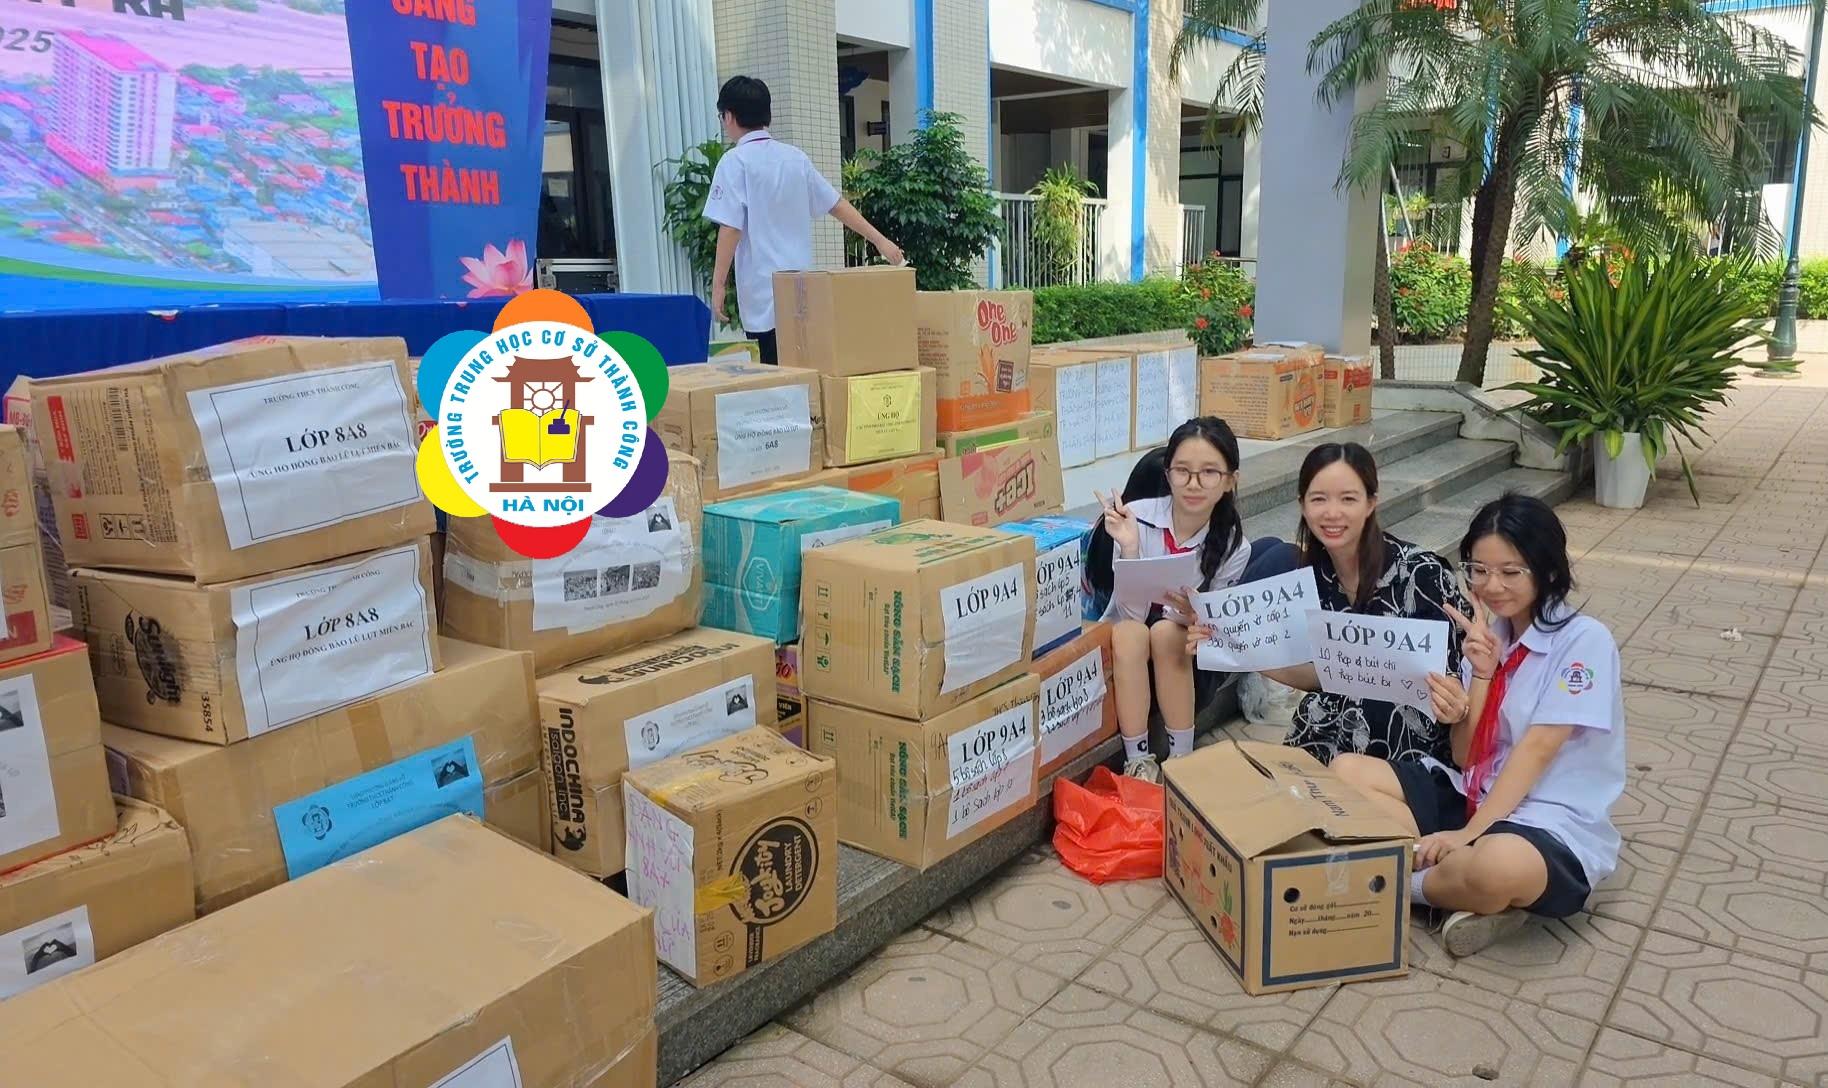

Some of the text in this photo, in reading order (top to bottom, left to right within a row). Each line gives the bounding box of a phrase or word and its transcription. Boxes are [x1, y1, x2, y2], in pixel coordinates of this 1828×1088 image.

[0, 27, 54, 53] 25
[410, 41, 470, 90] TẠO
[382, 91, 507, 149] TRƯỞNG
[400, 159, 501, 205] THÀNH
[286, 423, 368, 453] LỚP 8A8
[1037, 549, 1079, 584] ỚP 9A4
[956, 577, 1017, 618] LỚP 9A4
[1205, 581, 1304, 619] LỚP 9A4
[305, 607, 380, 641] LỚP 8A8
[1326, 620, 1431, 653] LỚP 9A4
[1047, 677, 1073, 706] LỚP
[1077, 660, 1097, 687] 9A4
[962, 730, 996, 763] LỚP
[1000, 716, 1026, 746] 9A4
[785, 842, 793, 891] LAUNDRY
[794, 834, 802, 892] DETERGENT
